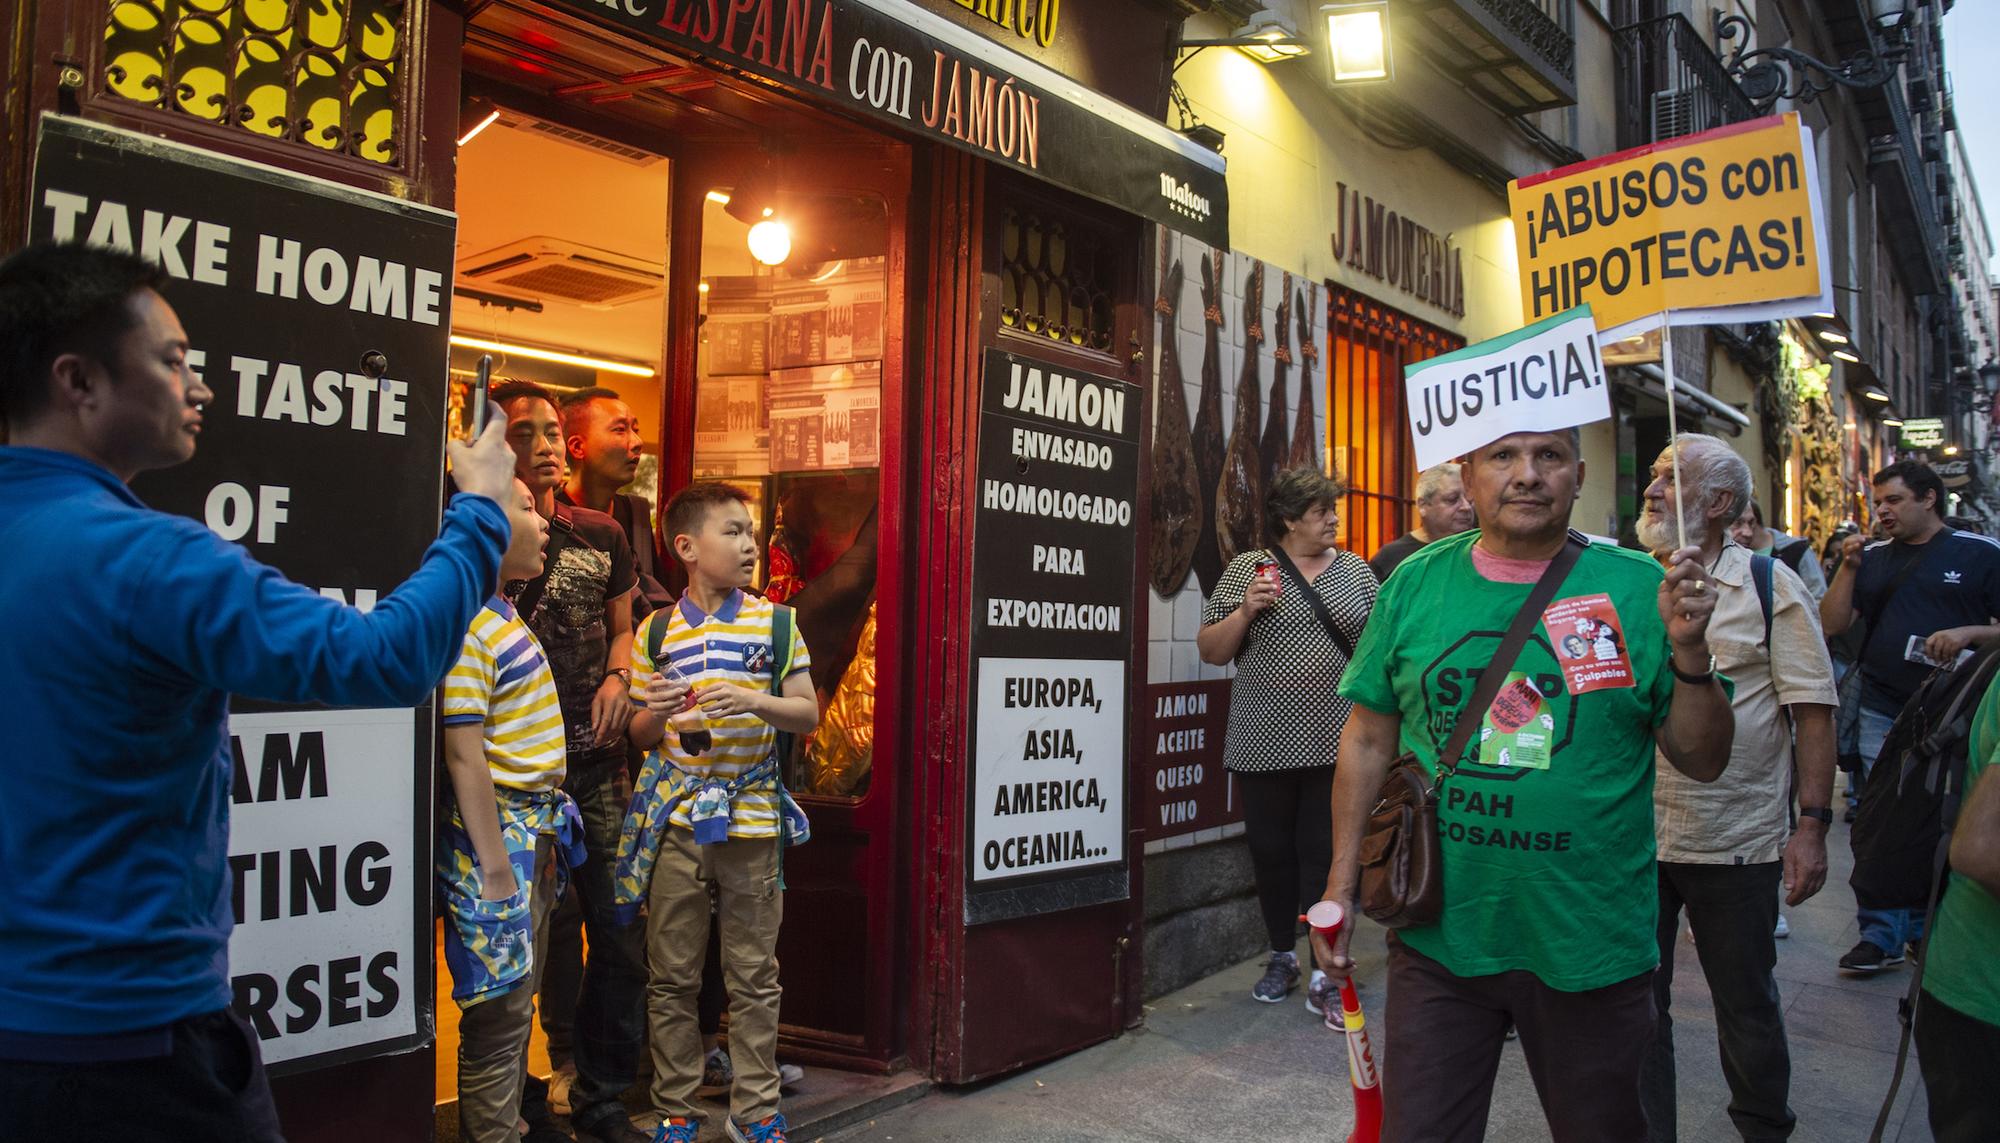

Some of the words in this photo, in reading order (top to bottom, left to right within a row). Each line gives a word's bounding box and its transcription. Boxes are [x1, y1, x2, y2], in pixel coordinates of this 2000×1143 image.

[849, 37, 913, 120] con
[922, 50, 1040, 169] JAMÓN
[1160, 172, 1211, 217] Mahou
[1526, 156, 1708, 259] ¡ABUSOS
[1721, 151, 1800, 201] con
[45, 189, 231, 287] TAKE
[256, 233, 443, 326] HOME
[1531, 216, 1806, 318] HIPOTECAS!
[230, 355, 409, 436] TASTE
[1003, 363, 1125, 434] JAMON
[1416, 334, 1601, 436] JUSTICIA!
[1012, 428, 1113, 472] ENVASADO
[205, 482, 290, 544] OF
[983, 479, 1131, 527] HOMOLOGADO
[1033, 544, 1085, 576] PARA
[987, 598, 1120, 632] EXPORTACION
[1004, 677, 1102, 714] EUROPA,
[1437, 668, 1564, 706] STP
[1575, 669, 1627, 683] Culpables
[1155, 693, 1208, 719] JAMON
[1023, 728, 1083, 764] ASIA,
[1156, 728, 1205, 755] ACEITE
[993, 778, 1107, 817] AMERICA,
[1156, 763, 1203, 792] QUESO
[1160, 799, 1197, 826] VINO
[1447, 786, 1515, 818] PAH
[983, 830, 1107, 871] OCEANIA...
